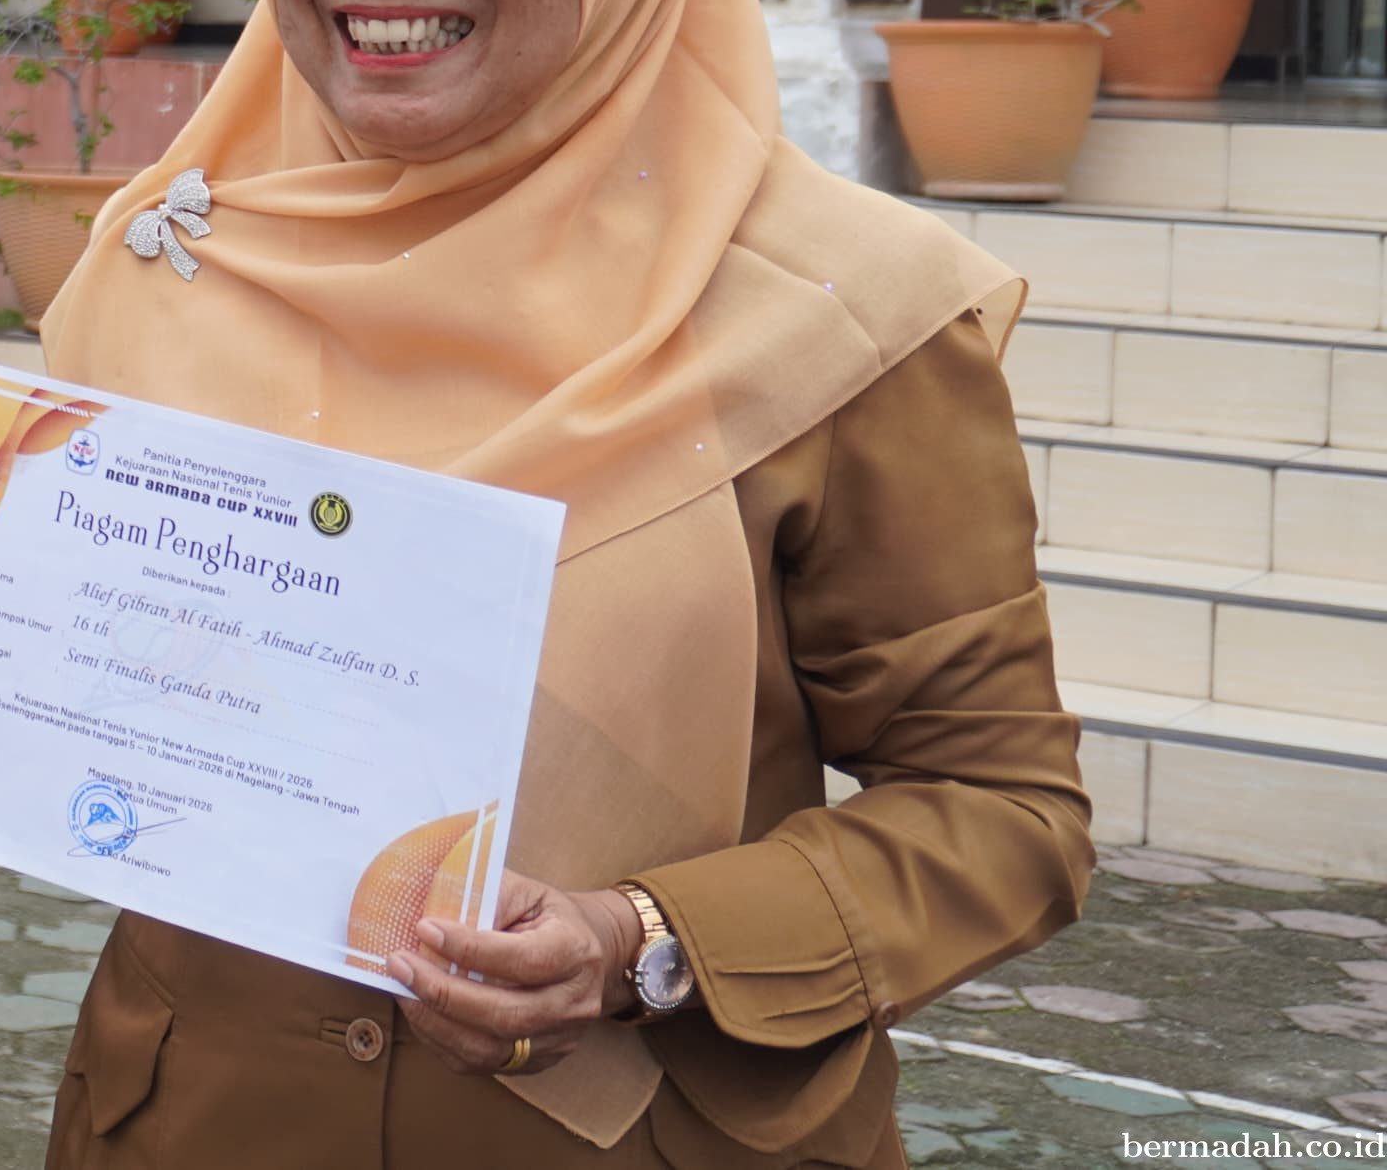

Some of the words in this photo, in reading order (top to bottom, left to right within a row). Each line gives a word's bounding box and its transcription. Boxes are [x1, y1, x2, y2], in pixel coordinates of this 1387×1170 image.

[114, 454, 169, 477] Kejuaraan
[171, 469, 219, 490] Nasional
[222, 481, 252, 498] Tenis
[255, 489, 291, 508] Yunior
[142, 446, 181, 466] Panitia
[183, 457, 266, 488] Penyelenggara
[253, 506, 297, 526] XXVIII
[55, 490, 147, 546] Piagam
[155, 517, 339, 596] Penghargaan
[141, 565, 187, 586] Diberikan
[189, 578, 225, 596] kepada
[27, 617, 51, 632] Umur
[72, 614, 89, 630] 16
[93, 620, 110, 636] th
[74, 582, 113, 606] Alief
[117, 593, 169, 618] Gibran
[169, 608, 197, 624] Al
[197, 614, 242, 638] Fatih
[252, 630, 318, 656] Ahmad
[317, 645, 374, 674] Zulfan
[379, 662, 398, 681] D.
[403, 670, 419, 686] S.
[63, 647, 100, 668] Semi
[103, 658, 156, 684] Finalis
[160, 674, 211, 700] Ganda
[215, 690, 261, 714] Putra
[14, 692, 58, 713] Kejuaraan
[60, 706, 100, 726] Nasional
[103, 718, 126, 734] Tenis
[129, 726, 159, 743] Yunior
[161, 736, 183, 750] New
[185, 743, 224, 763] Armada
[226, 755, 245, 769] Cup
[247, 761, 277, 778] XXVIII
[279, 771, 285, 779] /
[286, 773, 312, 788] 2026
[66, 722, 90, 736] pada
[92, 729, 127, 747] tanggal
[129, 739, 135, 749] 5
[147, 744, 156, 756] 10
[157, 749, 196, 766] Januari
[197, 760, 222, 774] 2026
[224, 768, 234, 778] di
[235, 770, 283, 794] Magelang
[292, 788, 319, 804] Jawa
[322, 796, 359, 814] Tengah
[138, 782, 147, 791] 10
[149, 785, 186, 803] Januari
[188, 798, 212, 813] 2026
[147, 797, 177, 814] Umum
[120, 853, 171, 876] Ariwibowo
